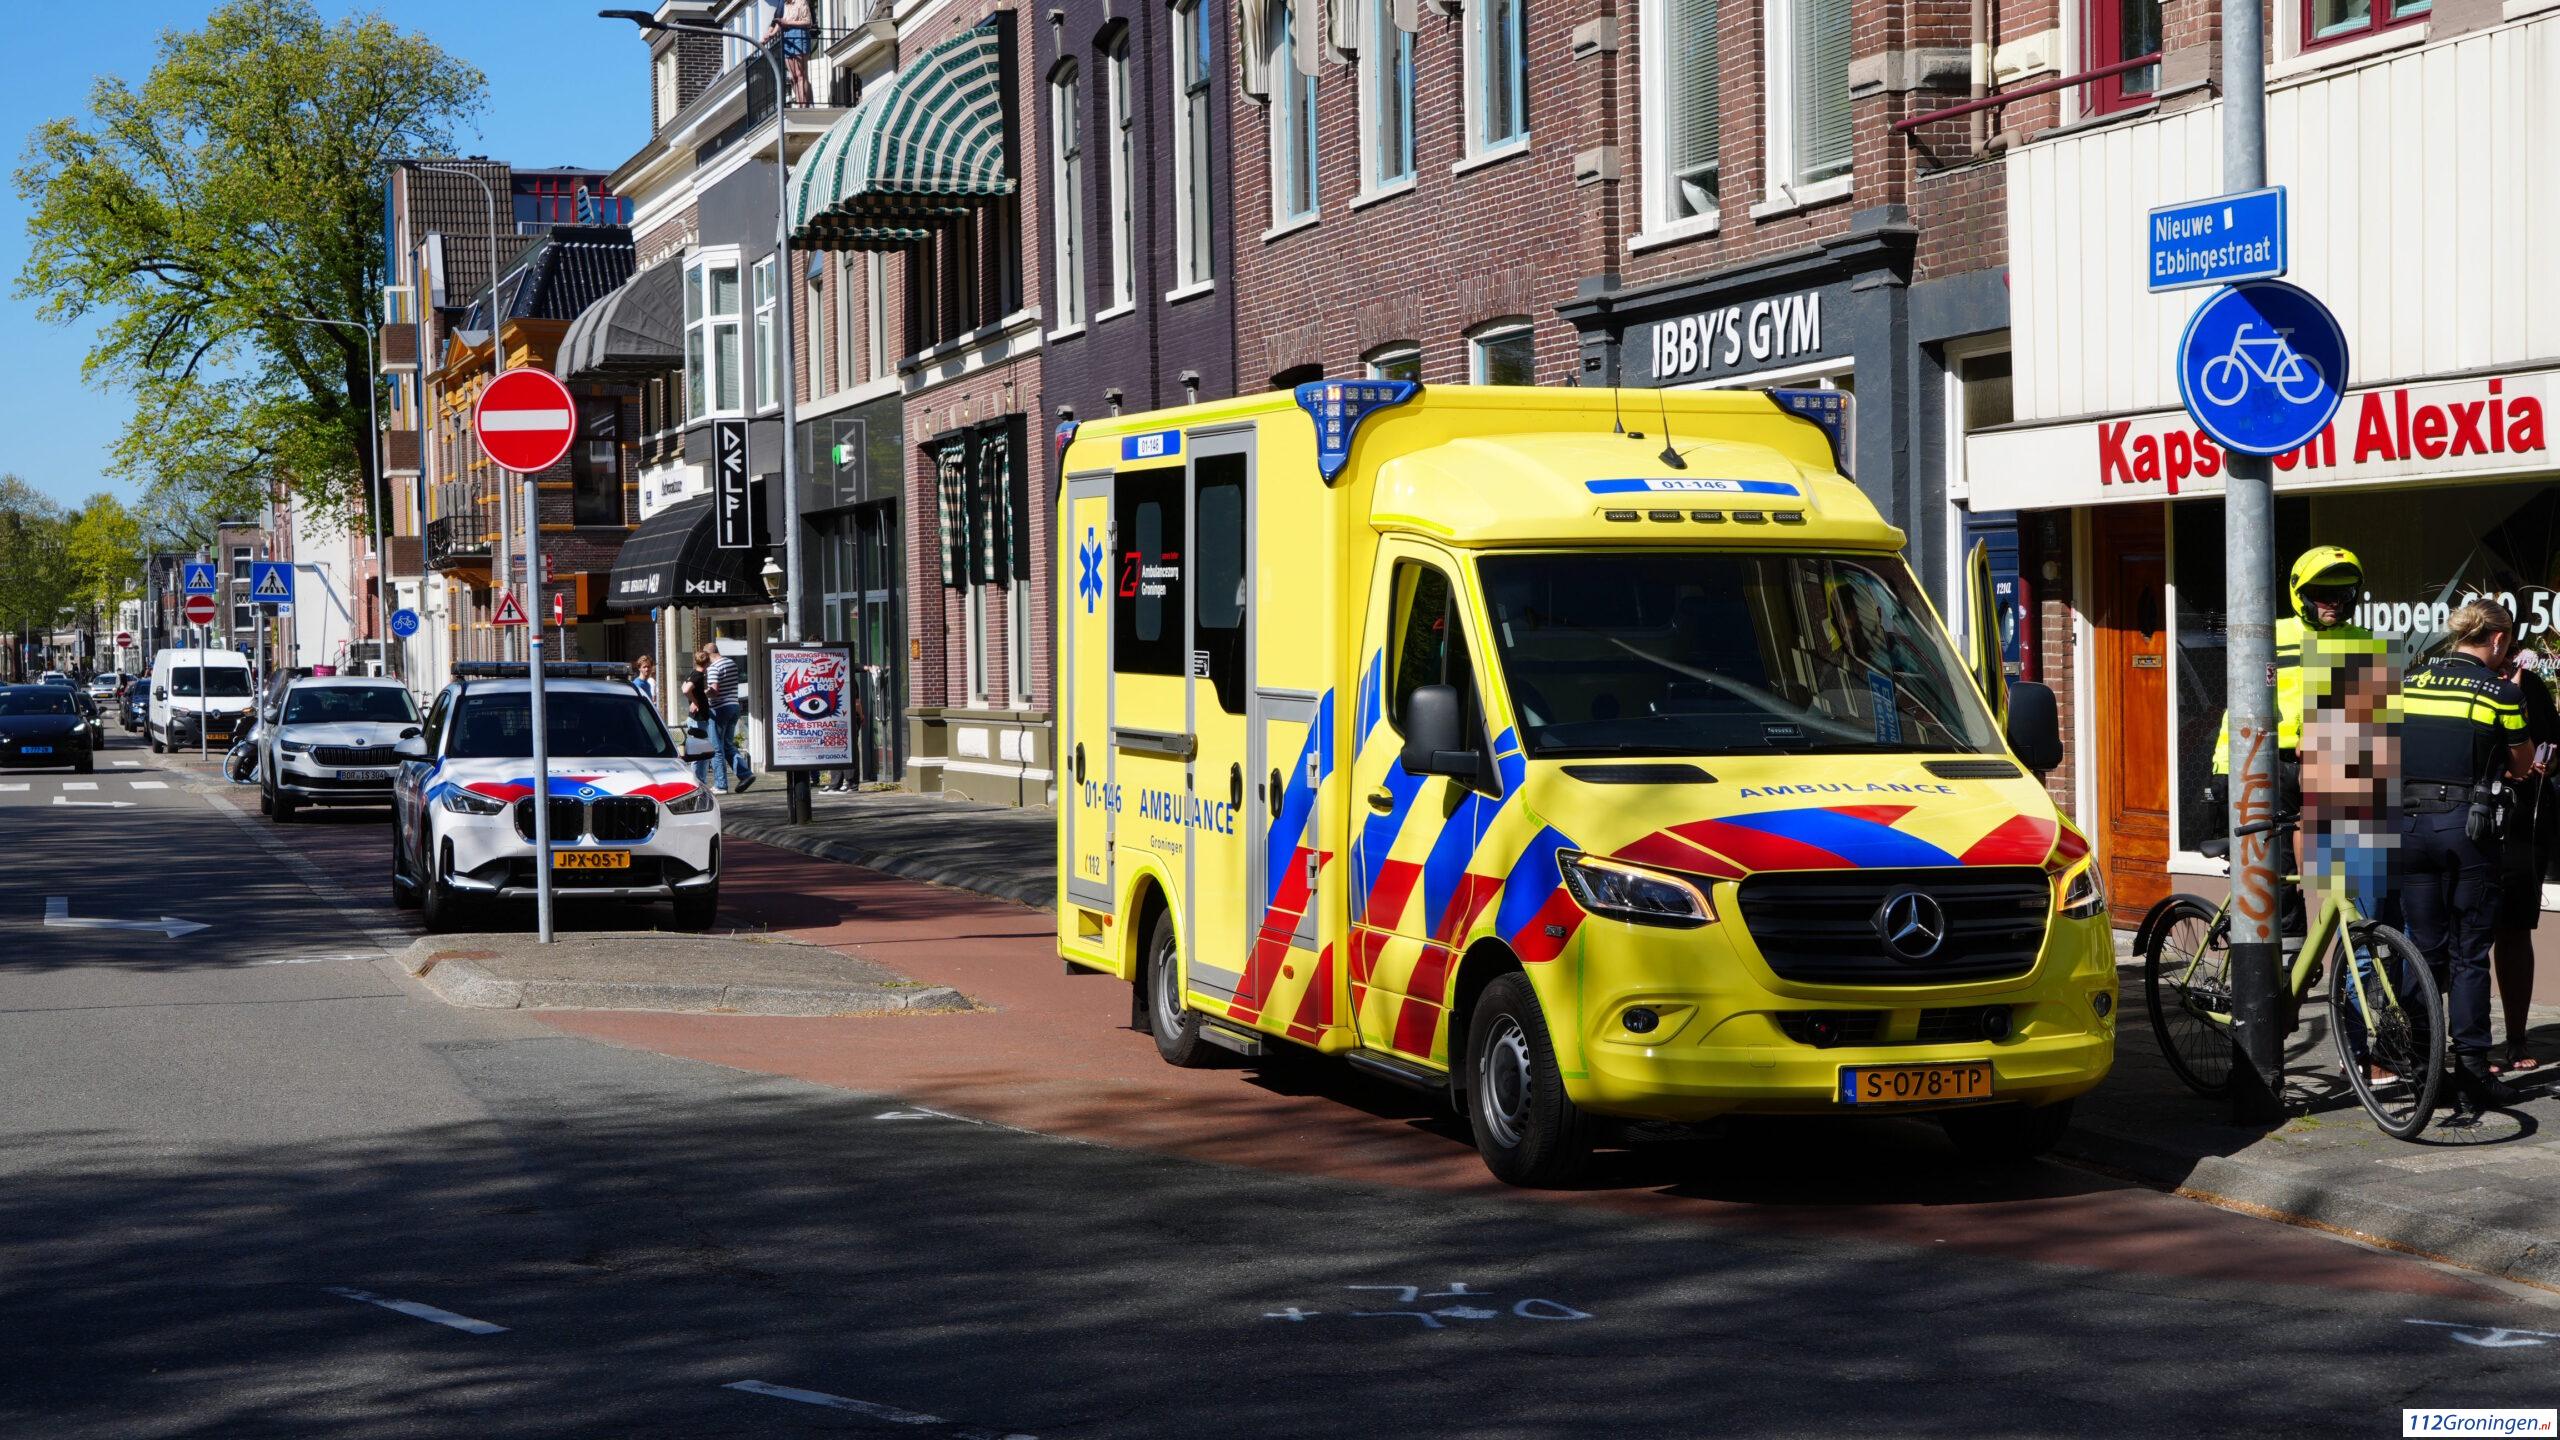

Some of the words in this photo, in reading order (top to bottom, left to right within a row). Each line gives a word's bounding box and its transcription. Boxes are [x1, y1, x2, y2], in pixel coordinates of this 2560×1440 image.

[2156, 214, 2213, 243] Nieuwe
[2156, 235, 2271, 277] Ebbingestraat
[1652, 306, 1742, 379] IBBY'S
[1748, 291, 1822, 360] GYM
[1141, 439, 1160, 453] 01-146
[2098, 420, 2337, 495] Kapsn
[2353, 377, 2546, 462] Alexia
[723, 425, 744, 544] DELFI
[1661, 480, 1728, 490] 01-146
[1141, 564, 1179, 580] Ambulancezorg
[686, 579, 727, 594] DELFI
[1141, 582, 1167, 598] Groningen
[784, 684, 817, 703] ELMER
[777, 728, 824, 737] JOSTIBAND
[806, 720, 838, 729] STRAAT
[1084, 779, 1122, 814] 01-146
[1740, 783, 1956, 799] AMBULANCE
[1139, 787, 1236, 836] AMBULANCE
[1149, 834, 1184, 856] Groningen
[558, 852, 628, 868] JPX-05-T
[1088, 855, 1101, 876] 112
[1866, 1069, 1982, 1098] S-078-TP
